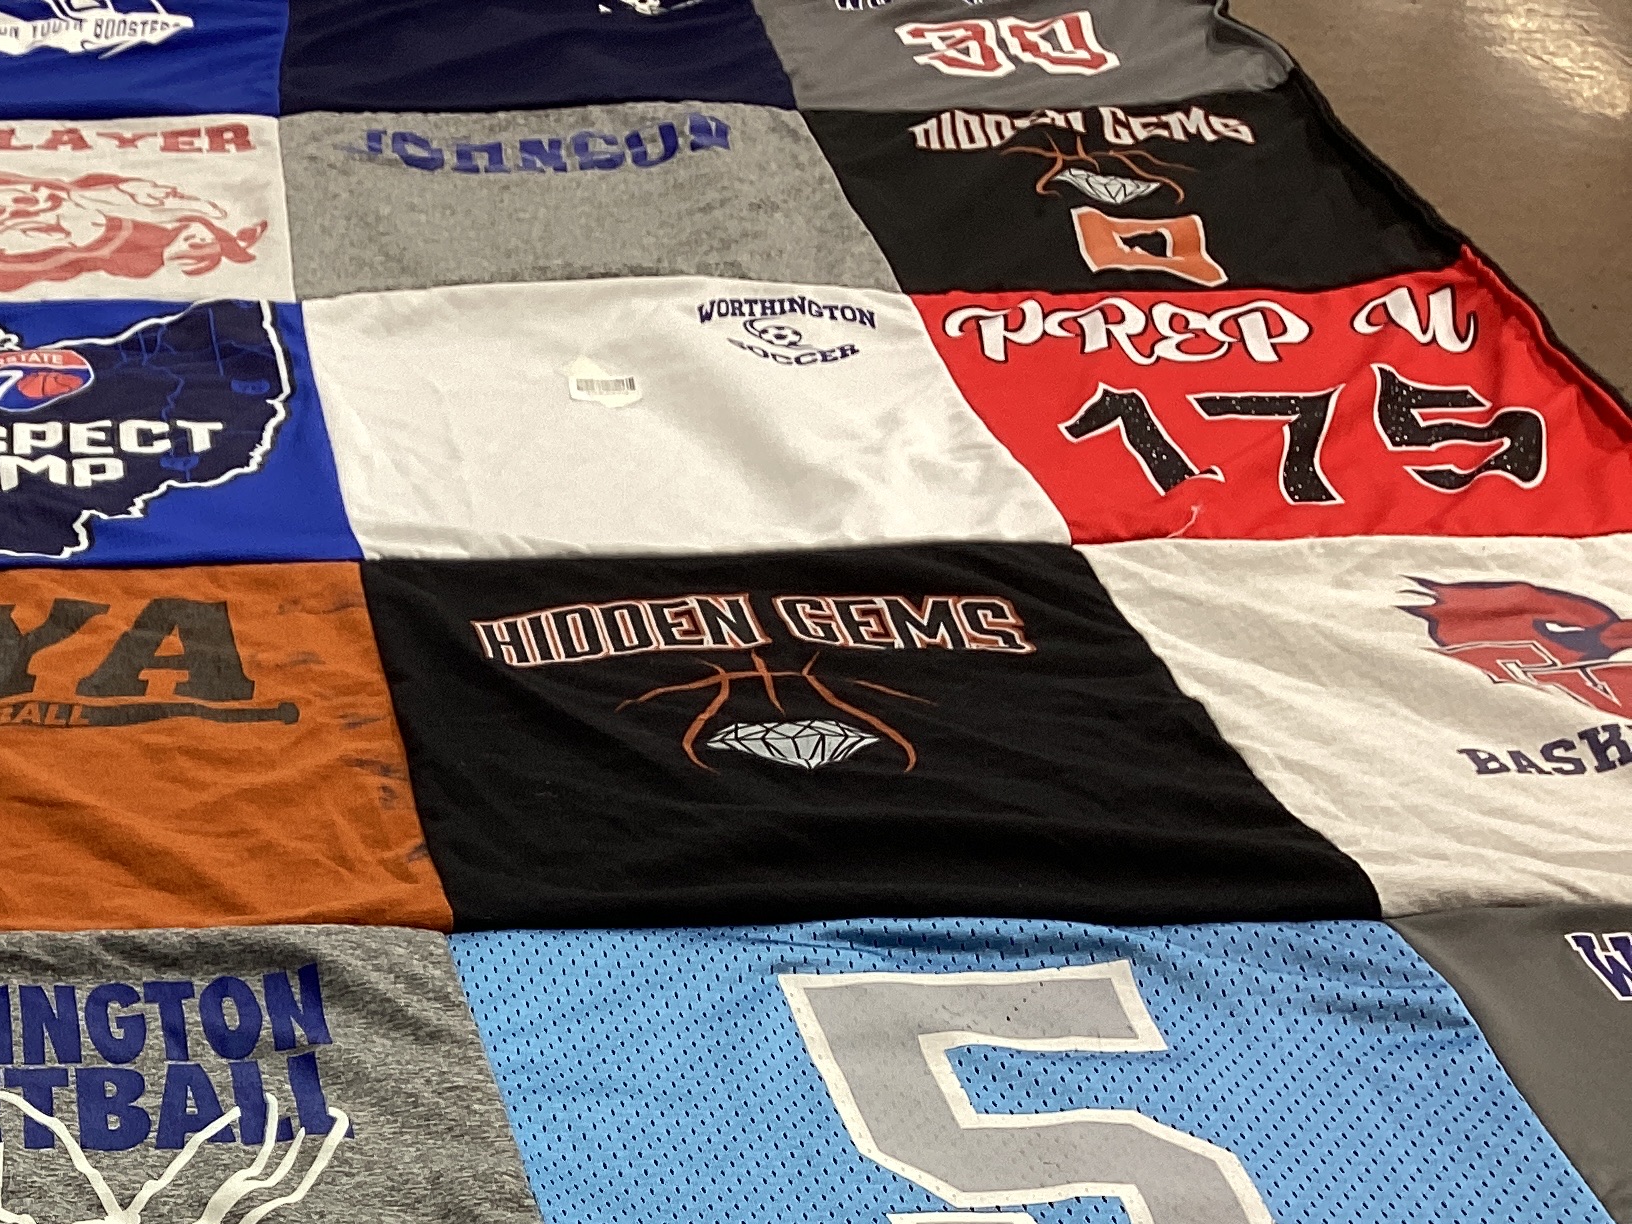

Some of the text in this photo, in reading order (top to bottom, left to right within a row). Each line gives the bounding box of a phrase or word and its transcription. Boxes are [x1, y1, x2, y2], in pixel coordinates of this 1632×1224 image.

[696, 296, 877, 330] WORTHINGTON
[943, 286, 1476, 367] PREP U
[1058, 363, 1548, 506] 175
[471, 593, 1037, 668] HIDDEN GEMS
